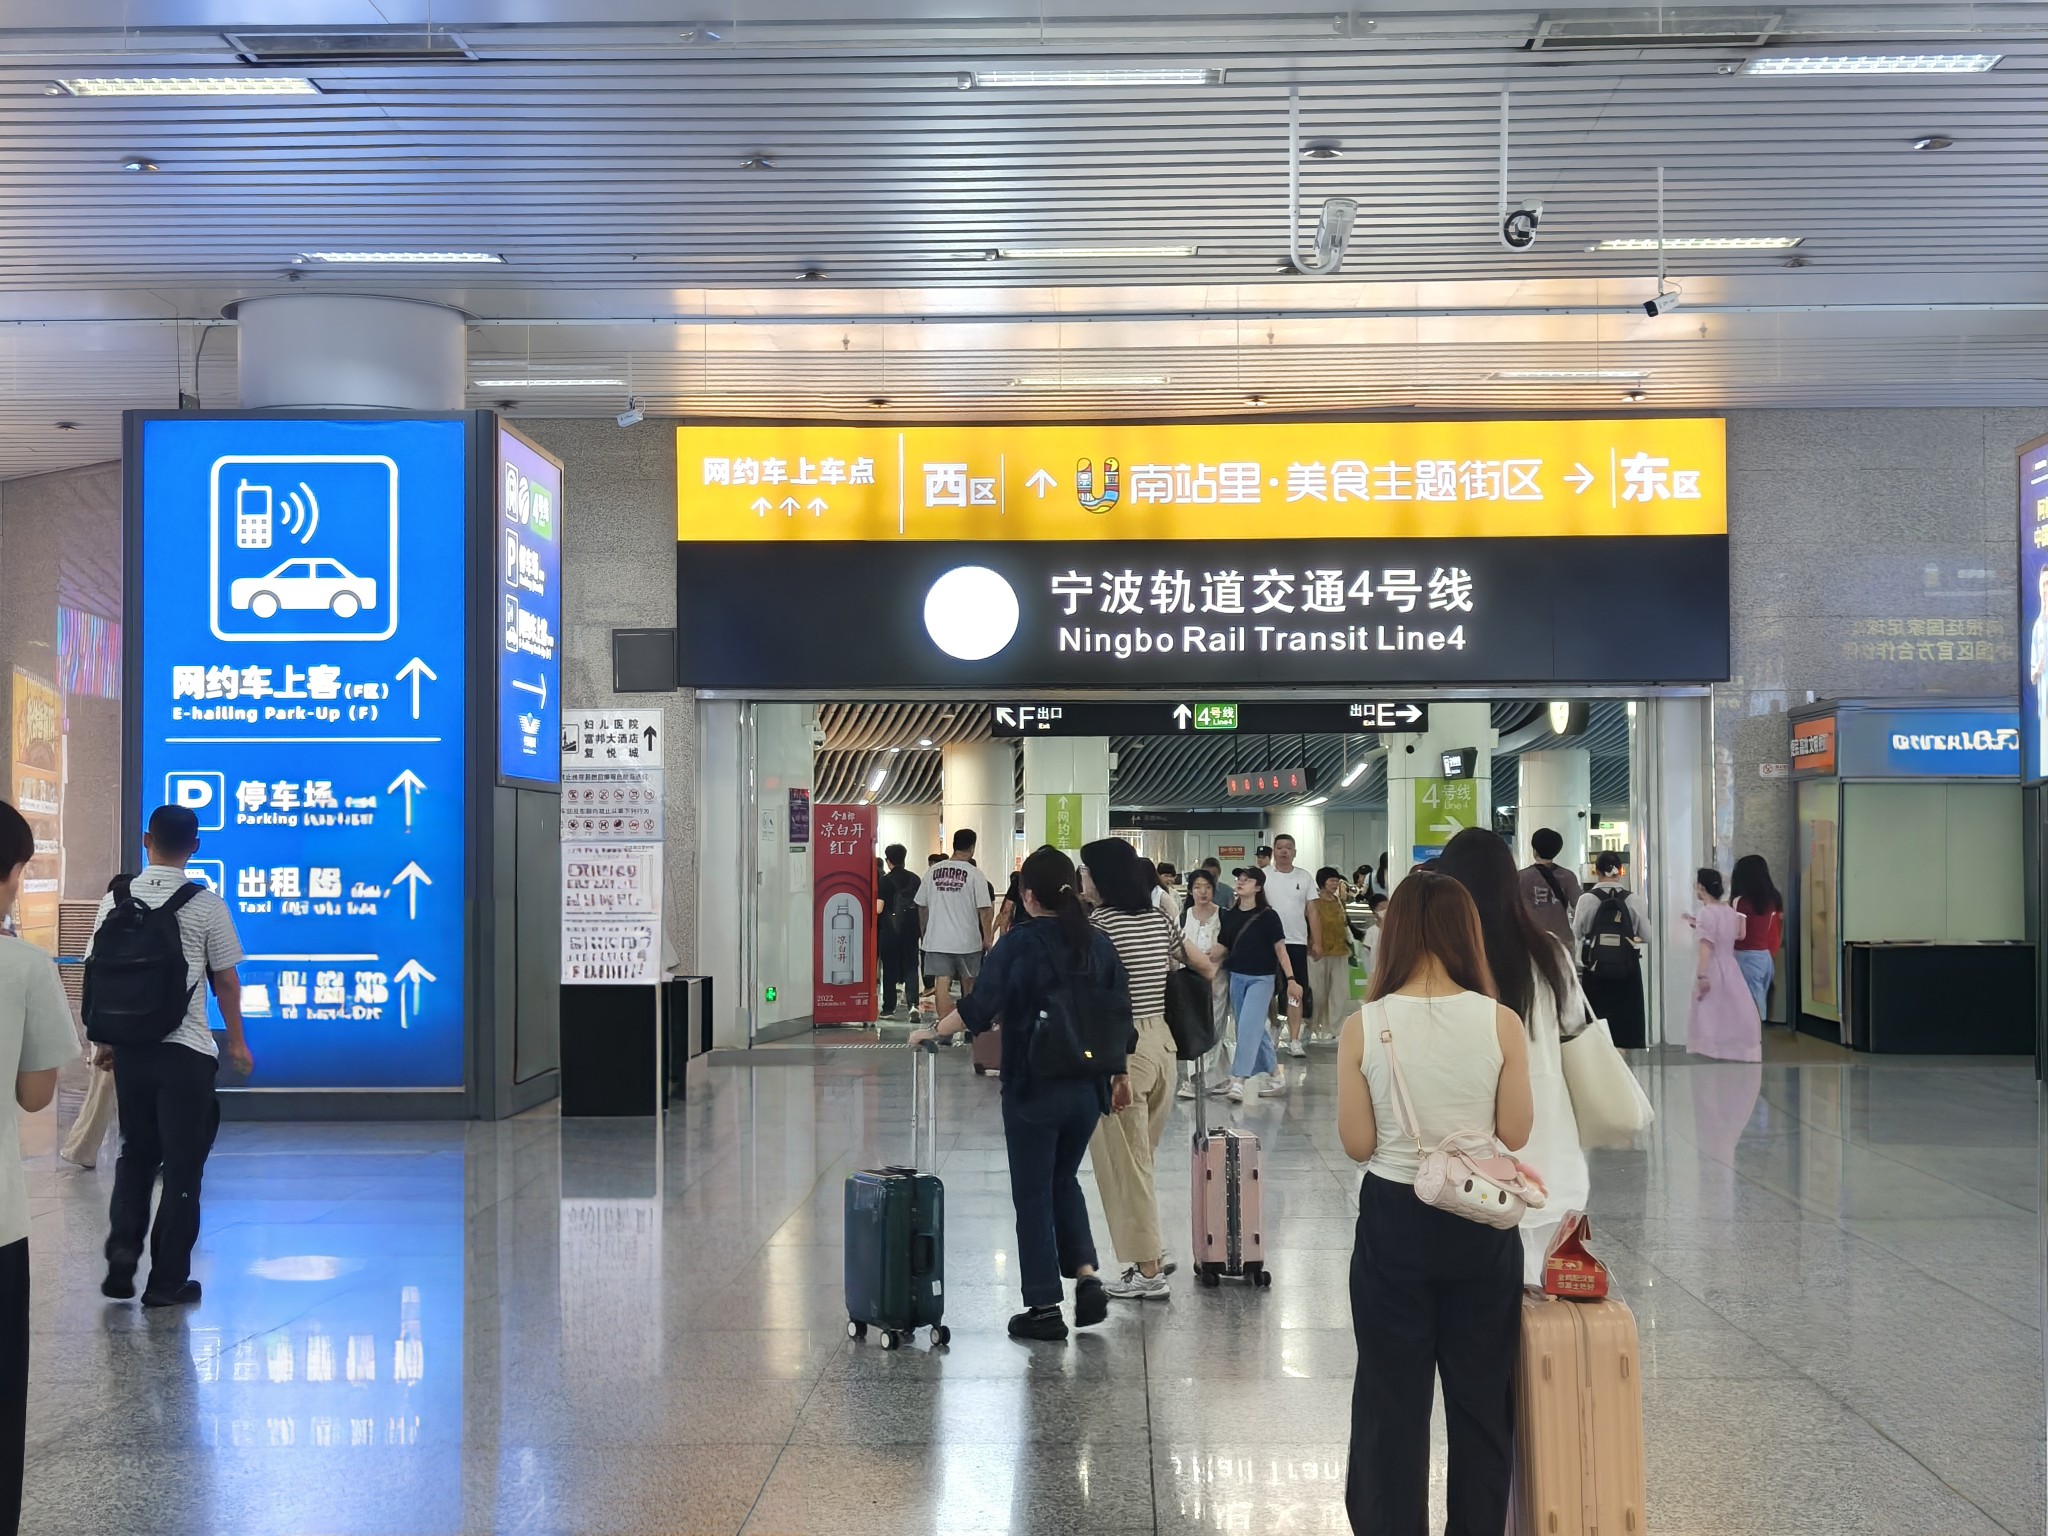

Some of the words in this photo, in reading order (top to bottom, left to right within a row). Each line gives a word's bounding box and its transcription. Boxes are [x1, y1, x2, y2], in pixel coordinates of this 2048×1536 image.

[703, 456, 875, 486] 网约车上车点
[1620, 451, 1702, 502] 东区
[922, 462, 997, 507] 西区
[1050, 567, 1474, 616] 宁波轨道交通4号线
[1059, 627, 1174, 659] Ningbo
[1183, 626, 1245, 653] Rail
[1254, 625, 1368, 652] Transit
[1377, 625, 1466, 651] Line4
[173, 705, 258, 723] E-hailing
[584, 719, 639, 730] 妇儿医院
[584, 733, 639, 744] 富邦大酒店
[236, 780, 332, 812] 停车场
[237, 812, 298, 827] Parking
[820, 822, 866, 838] 凉白开
[1058, 811, 1070, 848] 网约车
[830, 840, 858, 855] 红了
[238, 901, 272, 913] Taxi
